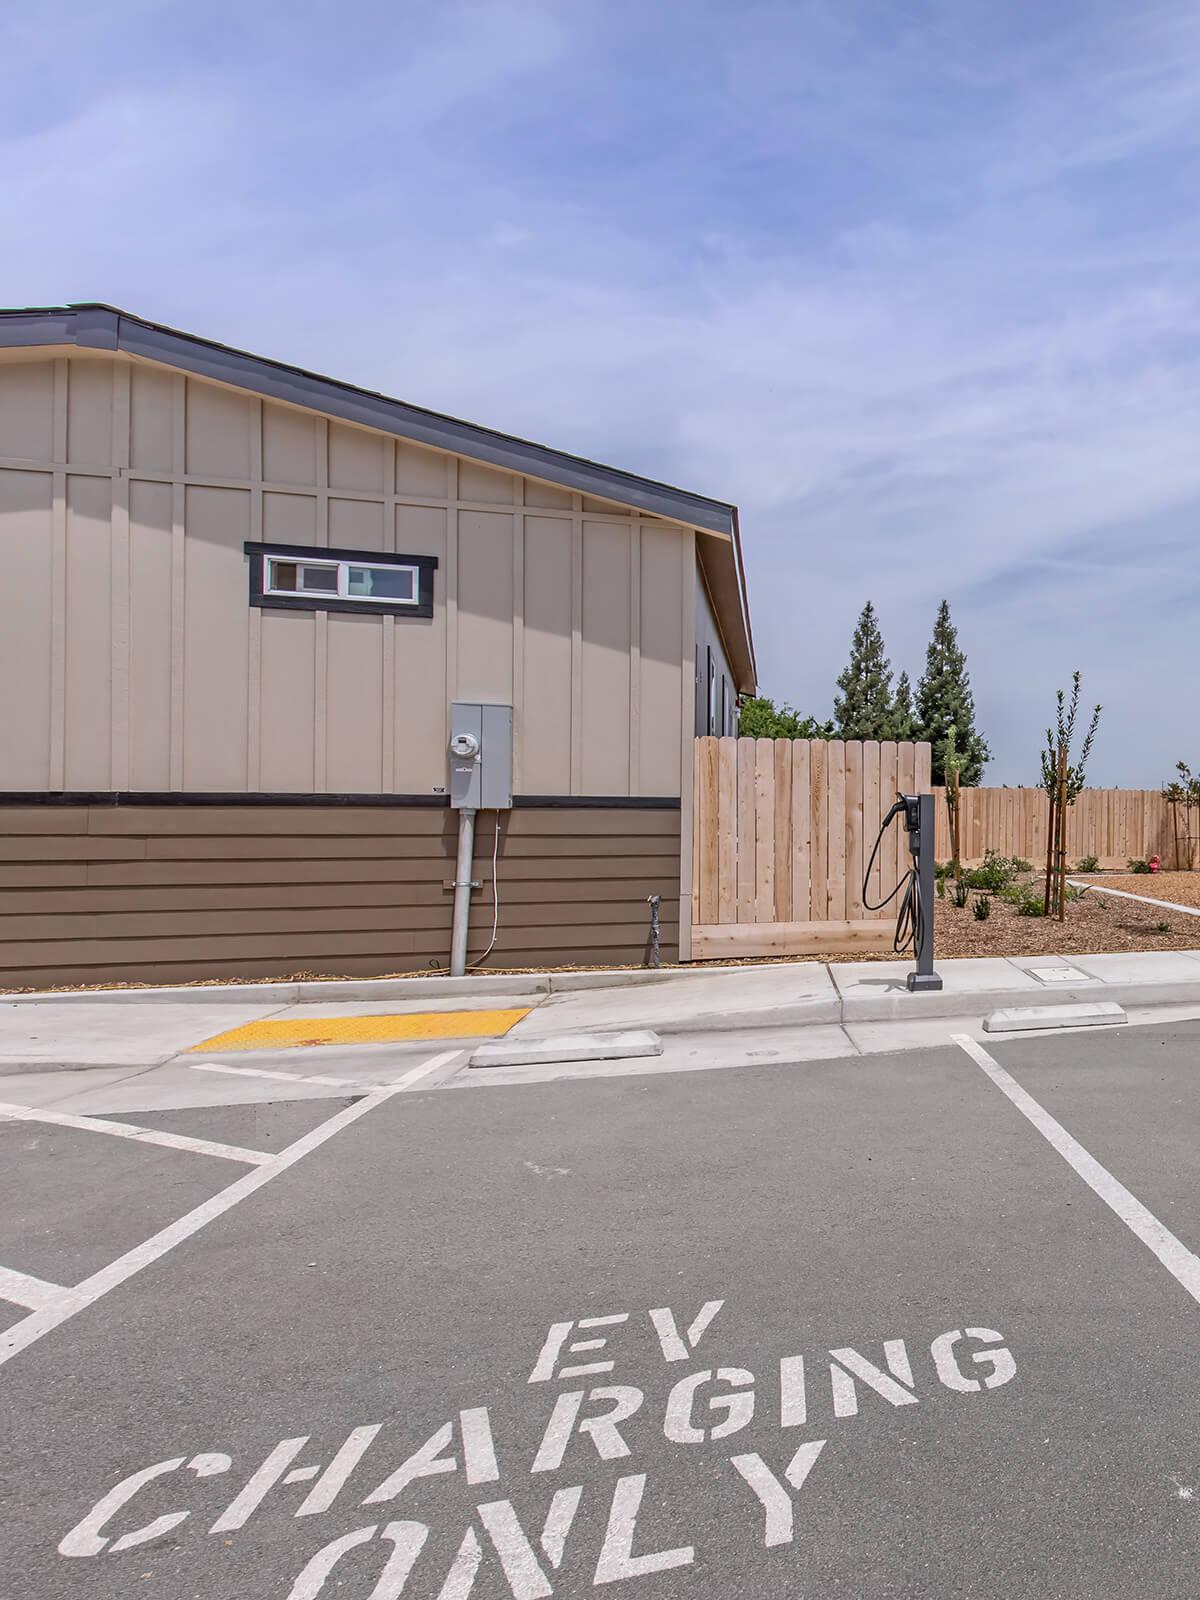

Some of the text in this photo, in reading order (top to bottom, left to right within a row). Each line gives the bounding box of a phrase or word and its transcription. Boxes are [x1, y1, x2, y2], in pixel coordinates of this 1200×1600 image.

[527, 1300, 725, 1384] EV
[57, 1327, 1017, 1558] CHARGING
[286, 1439, 827, 1600] ONLY
